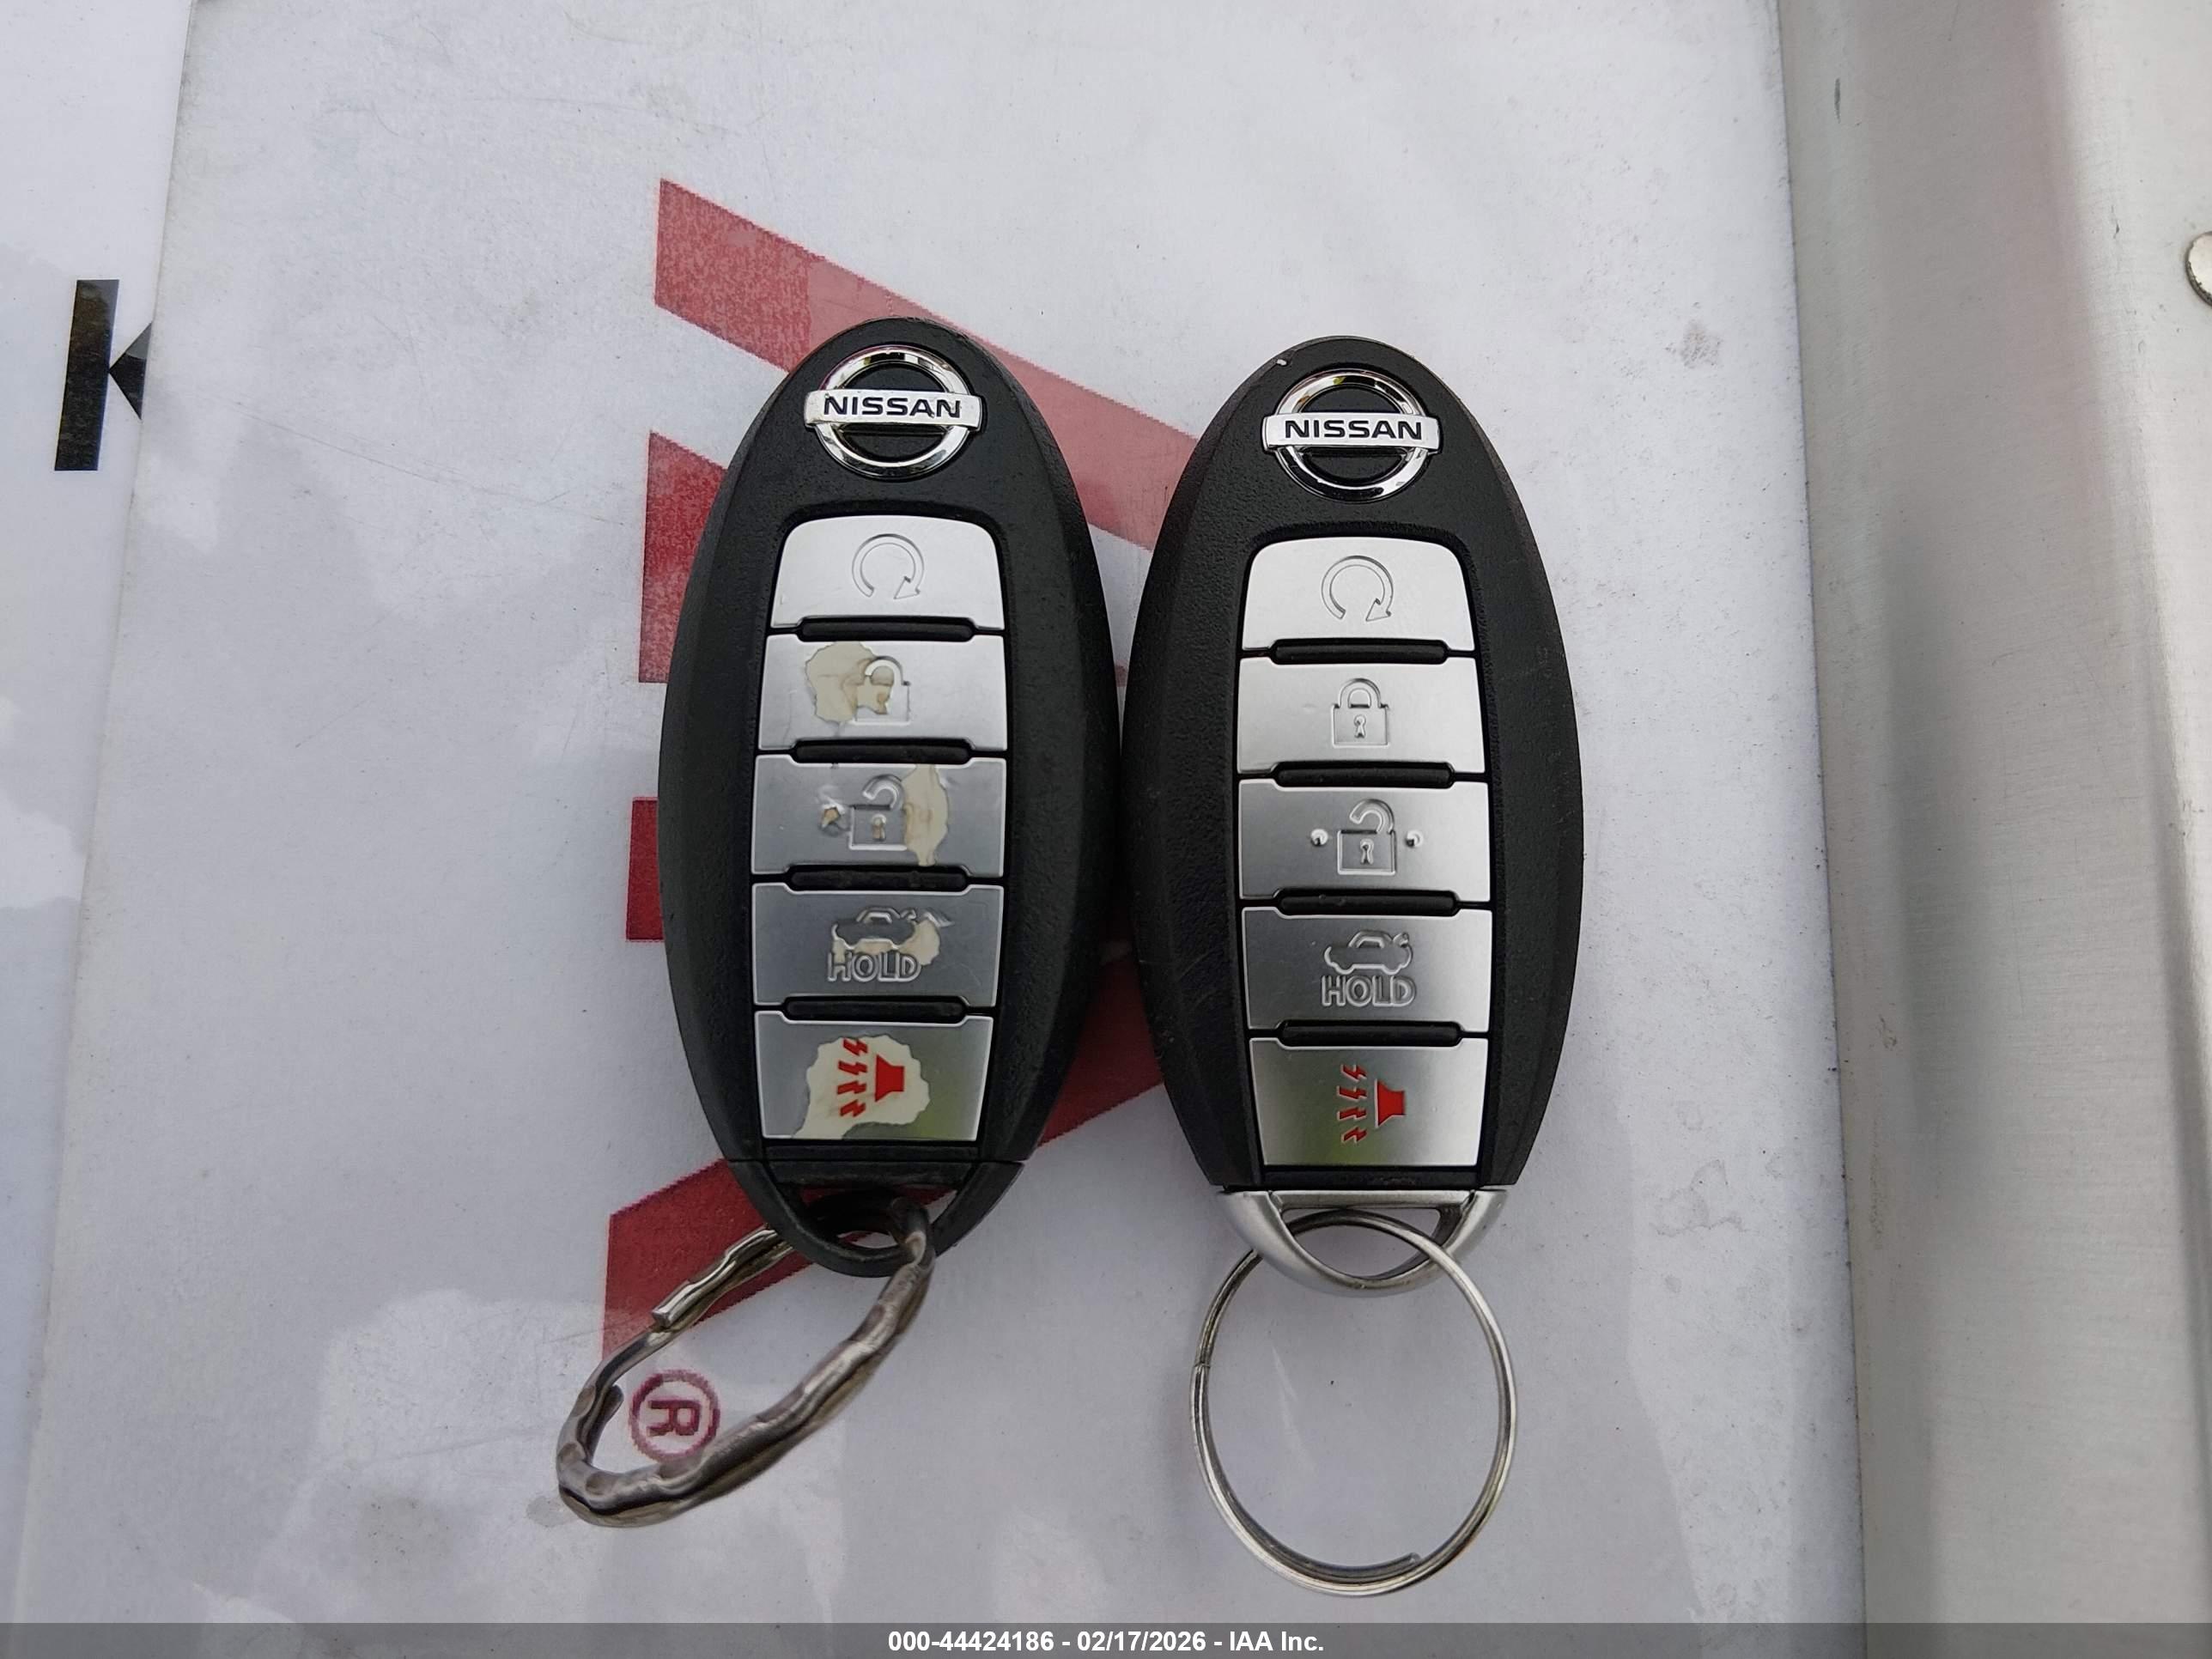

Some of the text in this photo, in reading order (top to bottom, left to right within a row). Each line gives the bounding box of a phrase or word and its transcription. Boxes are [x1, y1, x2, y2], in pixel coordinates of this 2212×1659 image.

[823, 395, 961, 419] NISSAN
[1285, 419, 1423, 441] NISSAN
[827, 951, 922, 982] HOLD
[1321, 975, 1417, 1007] HOLD
